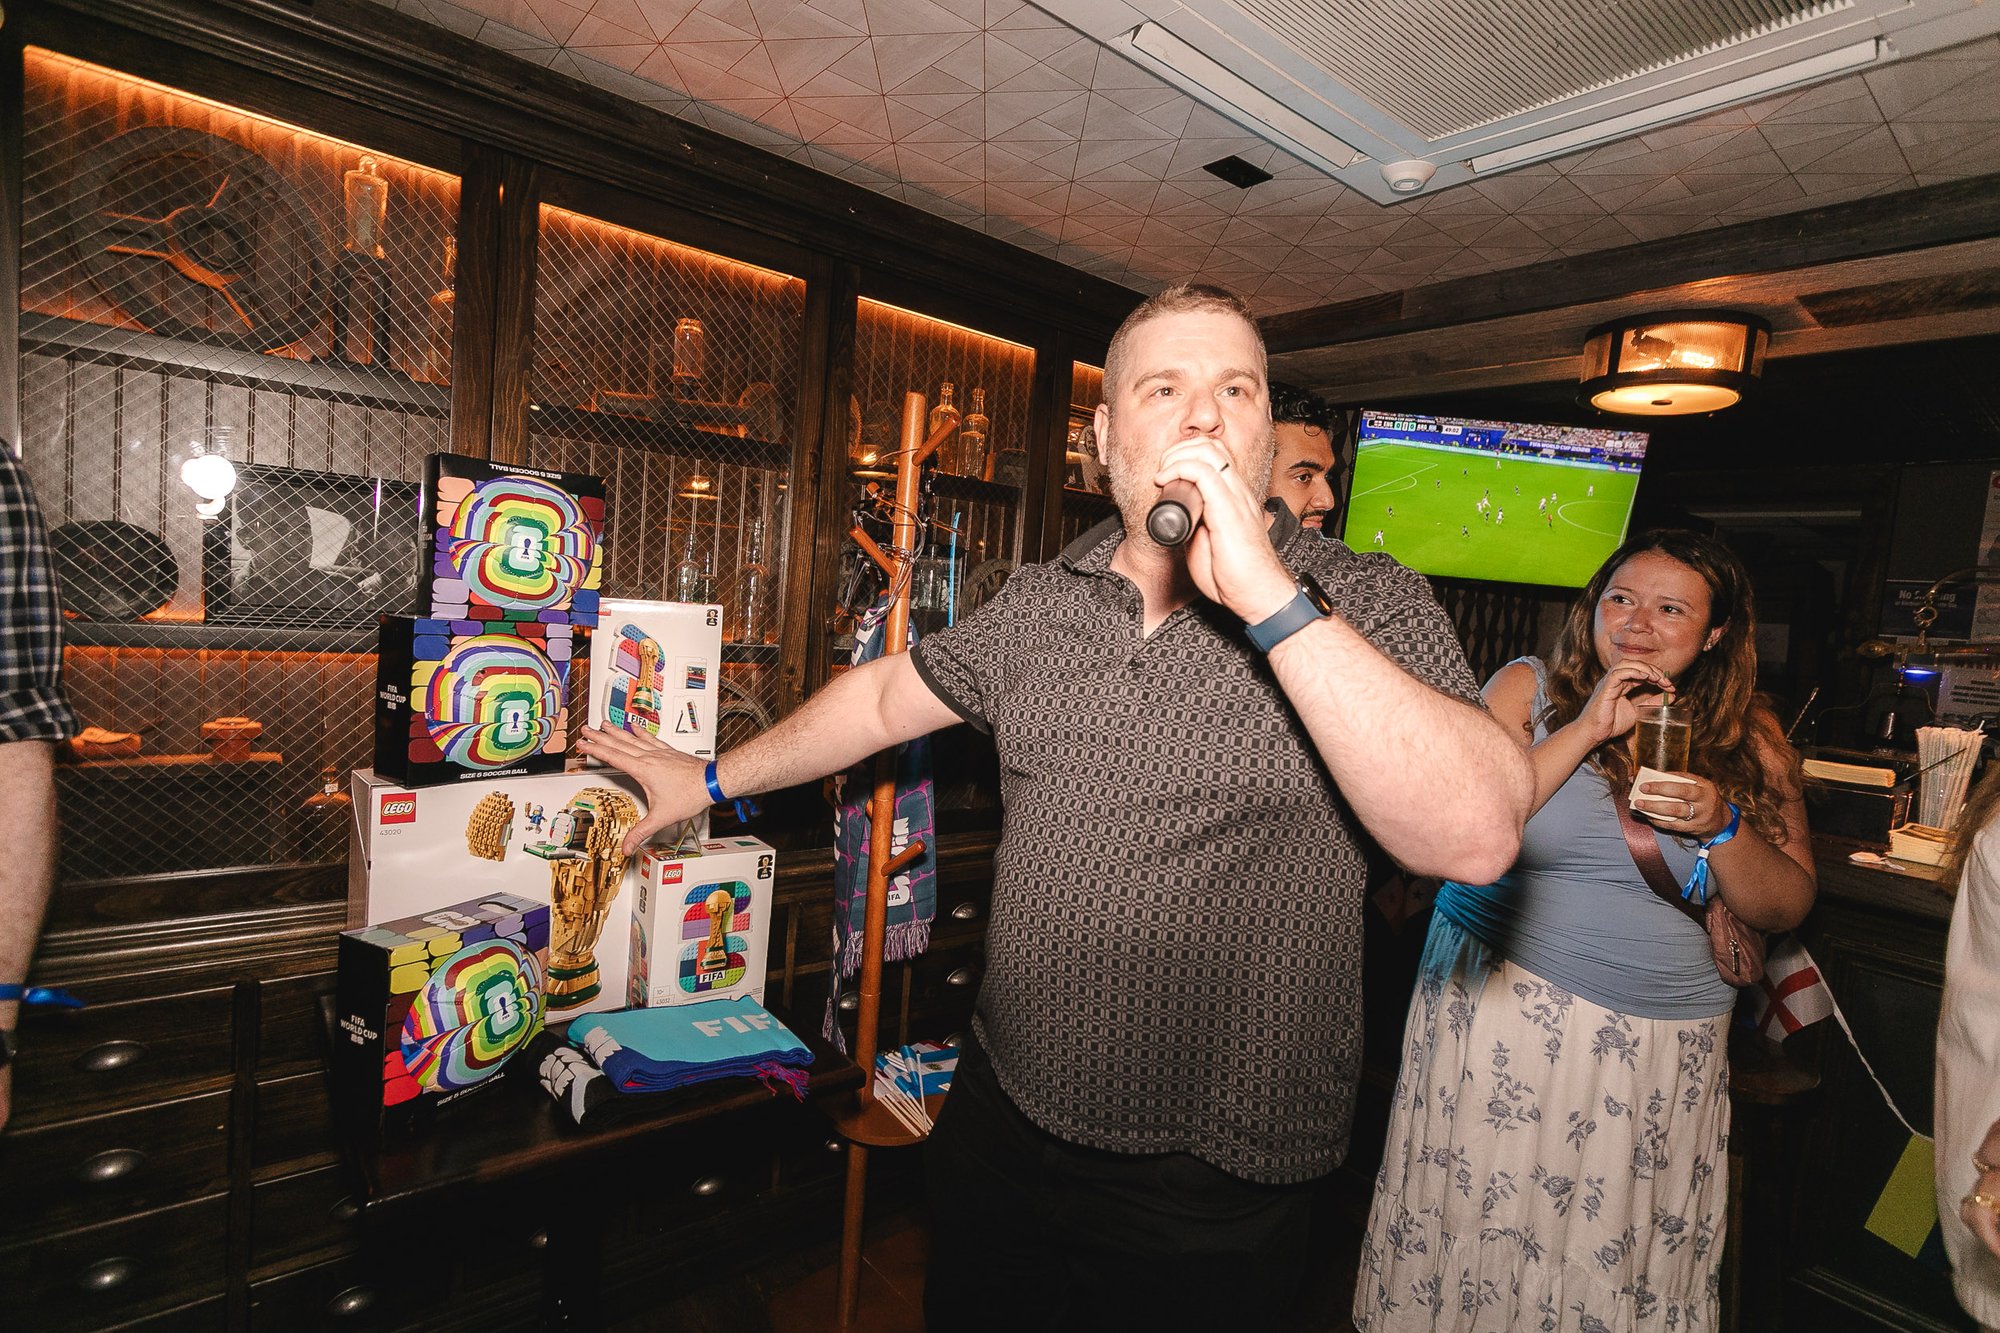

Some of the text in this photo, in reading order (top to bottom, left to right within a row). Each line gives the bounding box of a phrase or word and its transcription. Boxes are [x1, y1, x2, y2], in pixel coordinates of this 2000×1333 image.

[1624, 440, 1642, 449] FOX
[488, 463, 509, 472] BALL
[509, 466, 540, 477] SOCCER
[546, 472, 562, 480] SIZE
[1899, 589, 1957, 602] No Sing
[387, 684, 398, 694] FIFA
[380, 690, 407, 704] WORLD CUP
[630, 713, 648, 728] FIFA
[460, 772, 476, 780] SIZE
[482, 769, 511, 778] SOCCER
[383, 802, 414, 815] LEGO
[379, 828, 402, 836] 43020
[664, 869, 682, 879] LEGO
[887, 893, 901, 901] IFA
[702, 970, 724, 983] FIFA
[351, 1014, 365, 1028] FIFA
[340, 1018, 378, 1040] WORLD CUP
[436, 1094, 454, 1107] SIZE
